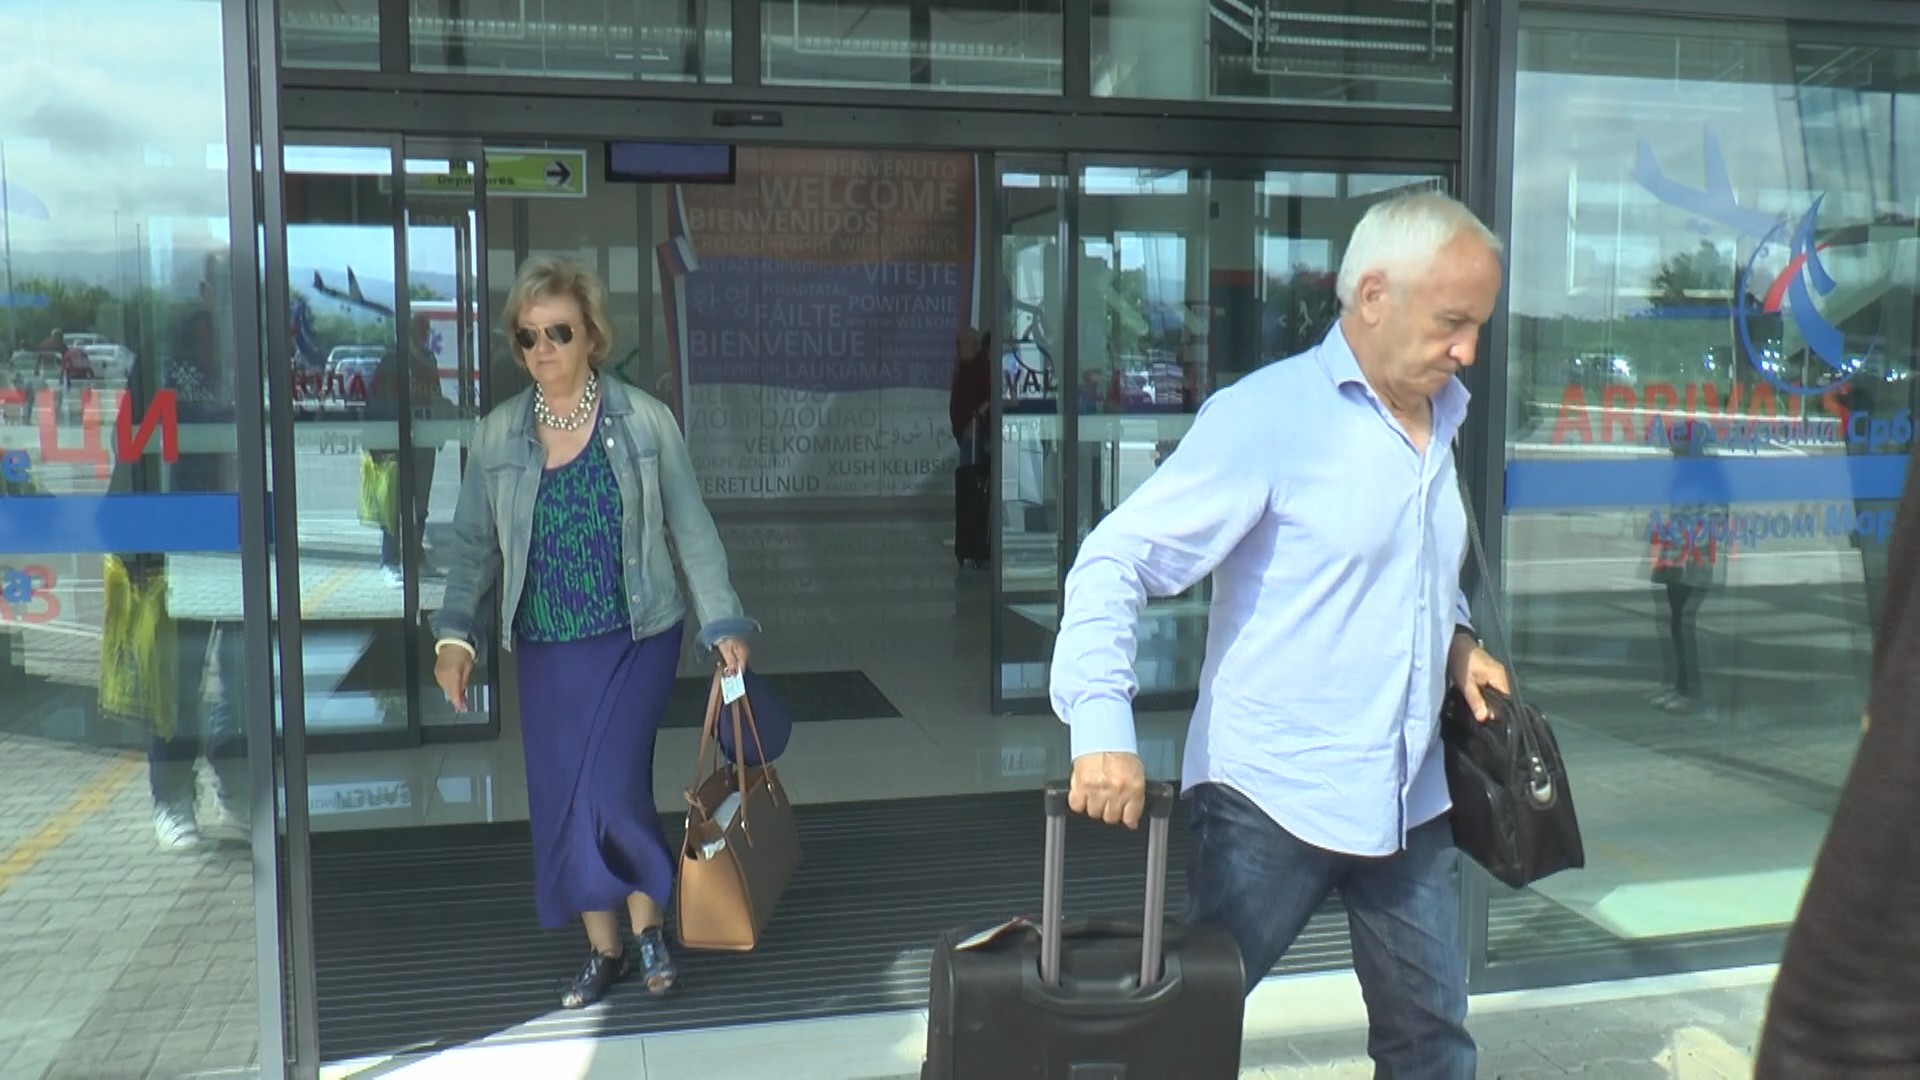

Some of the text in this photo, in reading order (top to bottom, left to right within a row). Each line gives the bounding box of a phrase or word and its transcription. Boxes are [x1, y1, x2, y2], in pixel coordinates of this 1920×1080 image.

[824, 157, 958, 179] BENVENUTO
[760, 176, 958, 213] WELCOME
[689, 207, 879, 234] BIENVENIDOS
[838, 235, 958, 253] WILLKOMMEN
[848, 294, 958, 313] POWITANIE
[896, 315, 958, 329] WELKOM
[690, 330, 865, 357] BIENVENUE
[785, 361, 903, 380] LAUKIAMAS
[1552, 382, 1851, 445] ARRIVALS
[743, 435, 881, 454] VELKOMMEN
[826, 459, 877, 475] XUSH
